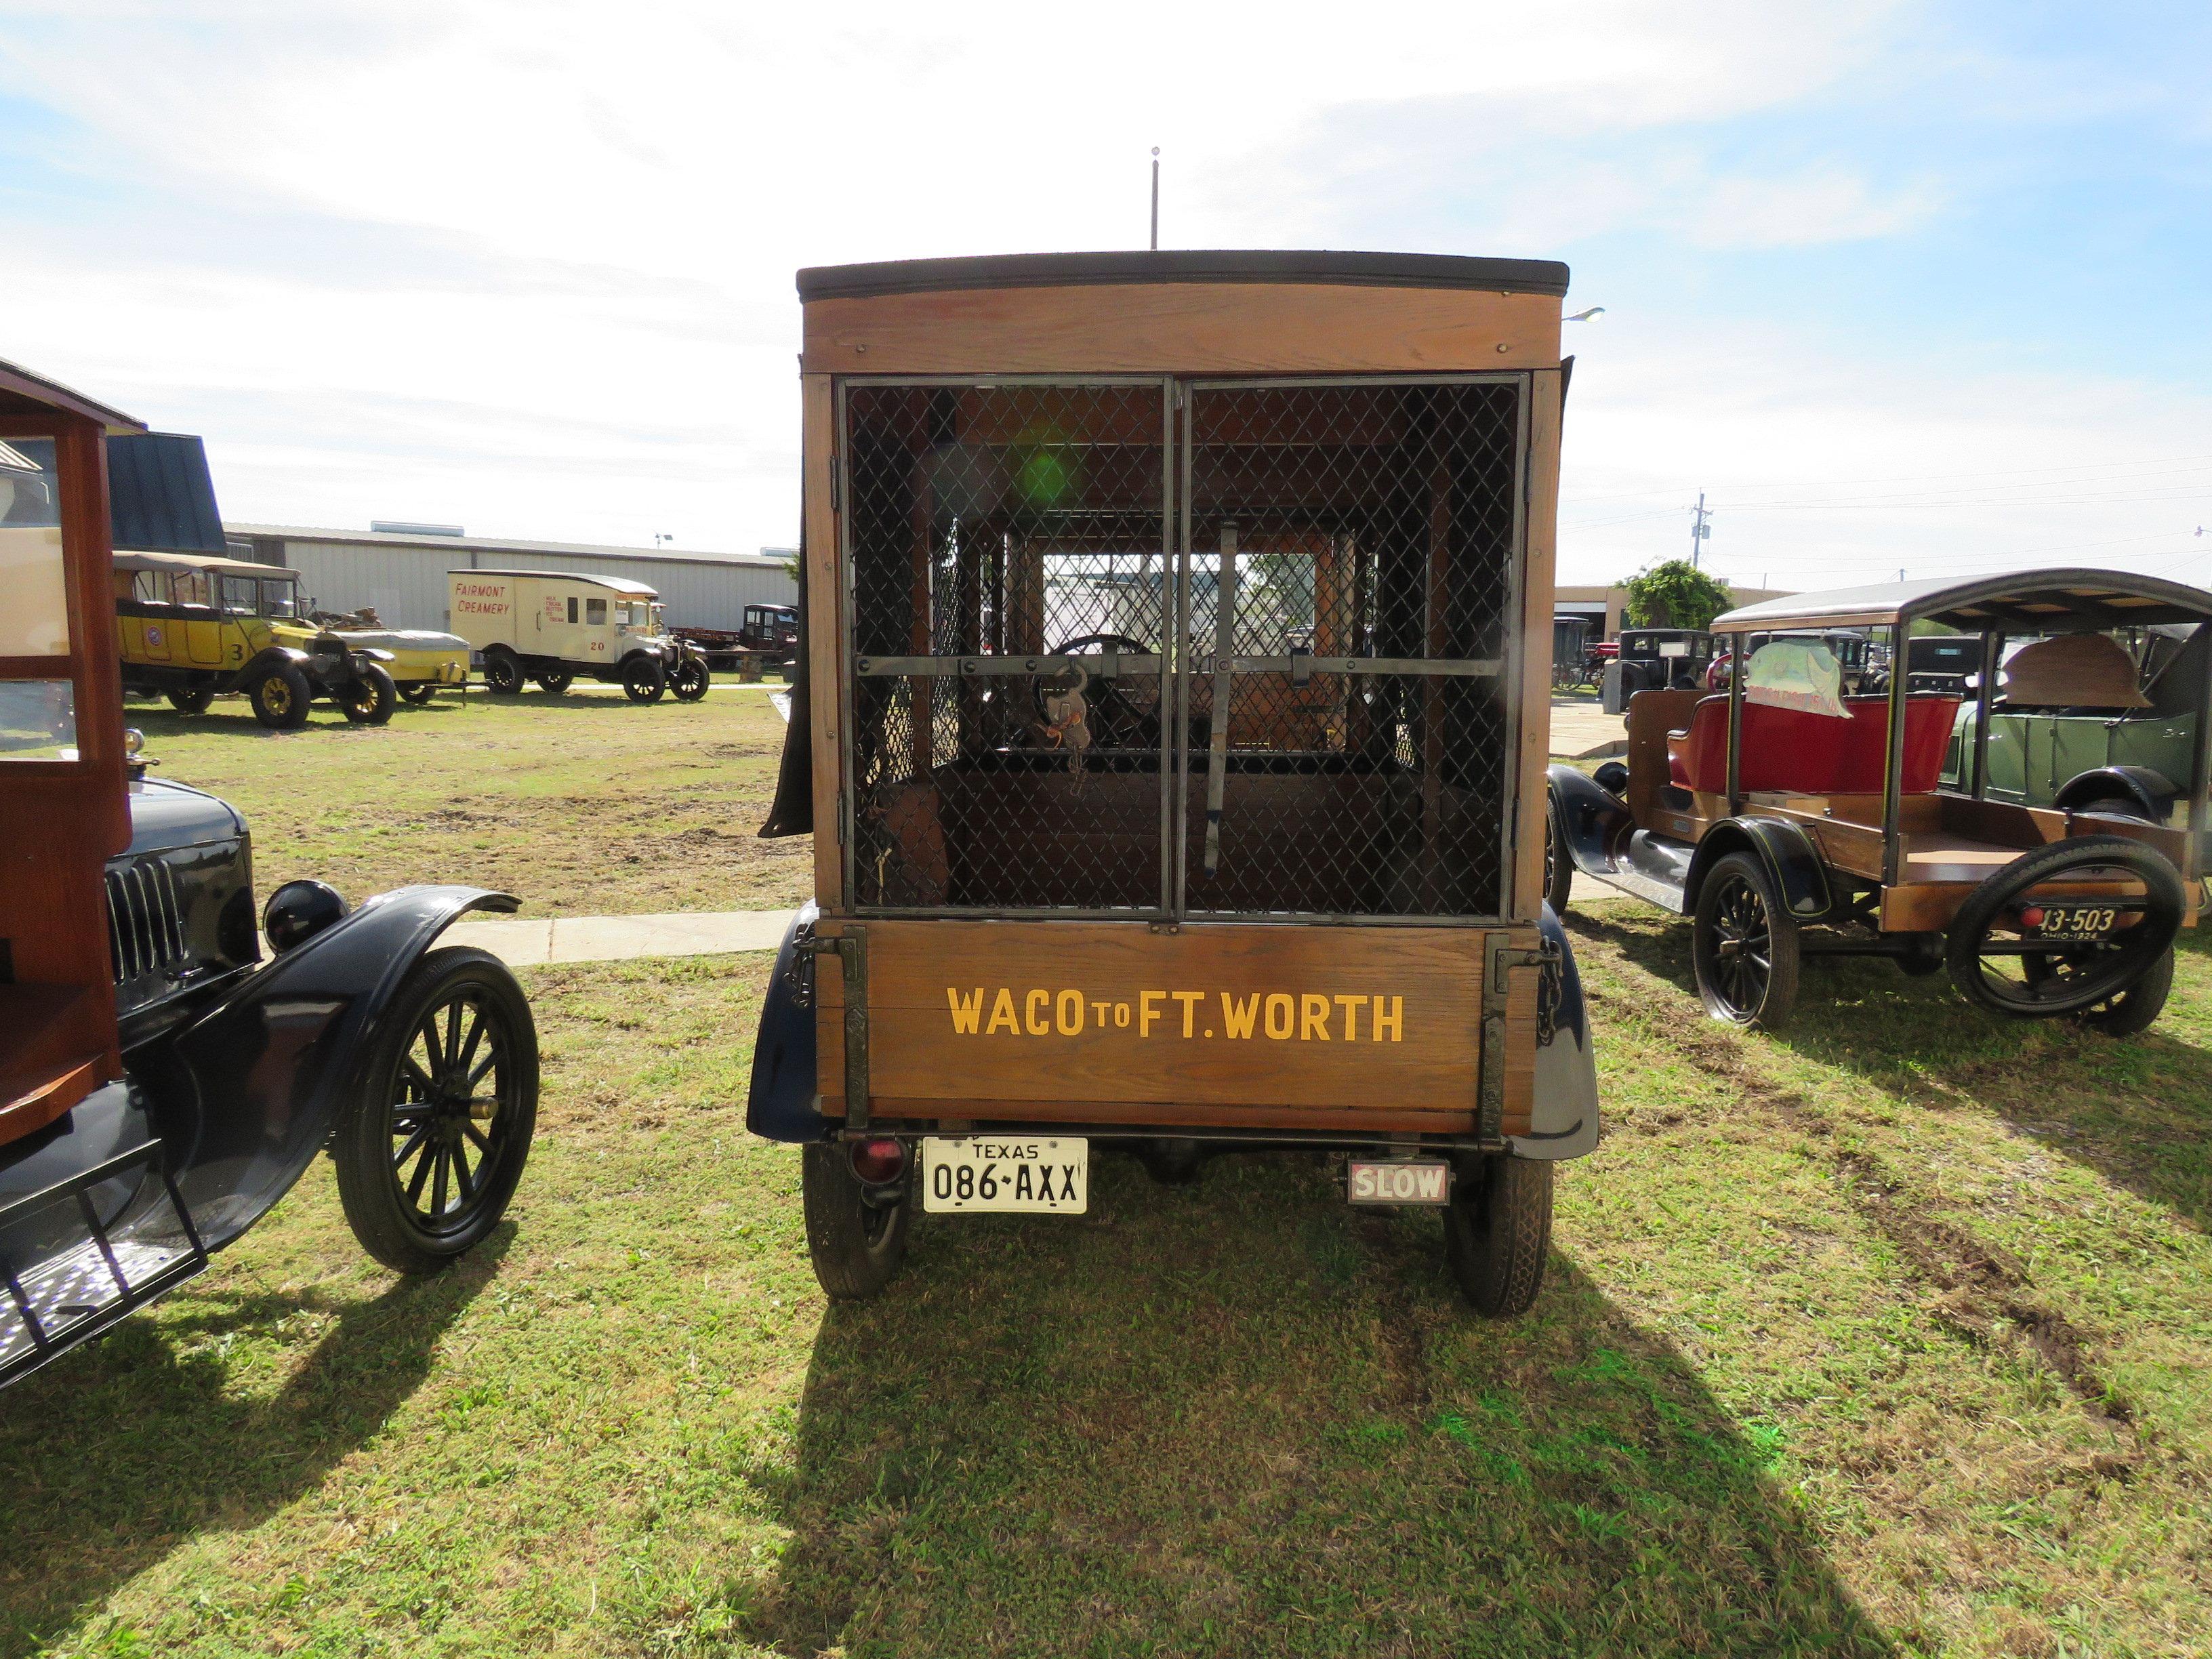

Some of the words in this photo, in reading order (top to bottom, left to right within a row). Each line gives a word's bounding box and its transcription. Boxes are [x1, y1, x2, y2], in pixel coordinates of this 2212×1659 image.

[455, 583, 506, 598] FAIRMONT
[458, 600, 510, 615] CREAMERY
[231, 643, 244, 661] 3
[590, 642, 605, 651] 20
[947, 987, 1084, 1036] WACO
[1091, 1002, 1130, 1028] TO
[972, 1143, 1039, 1160] TEXAS
[1355, 1168, 1444, 1199] SLOW
